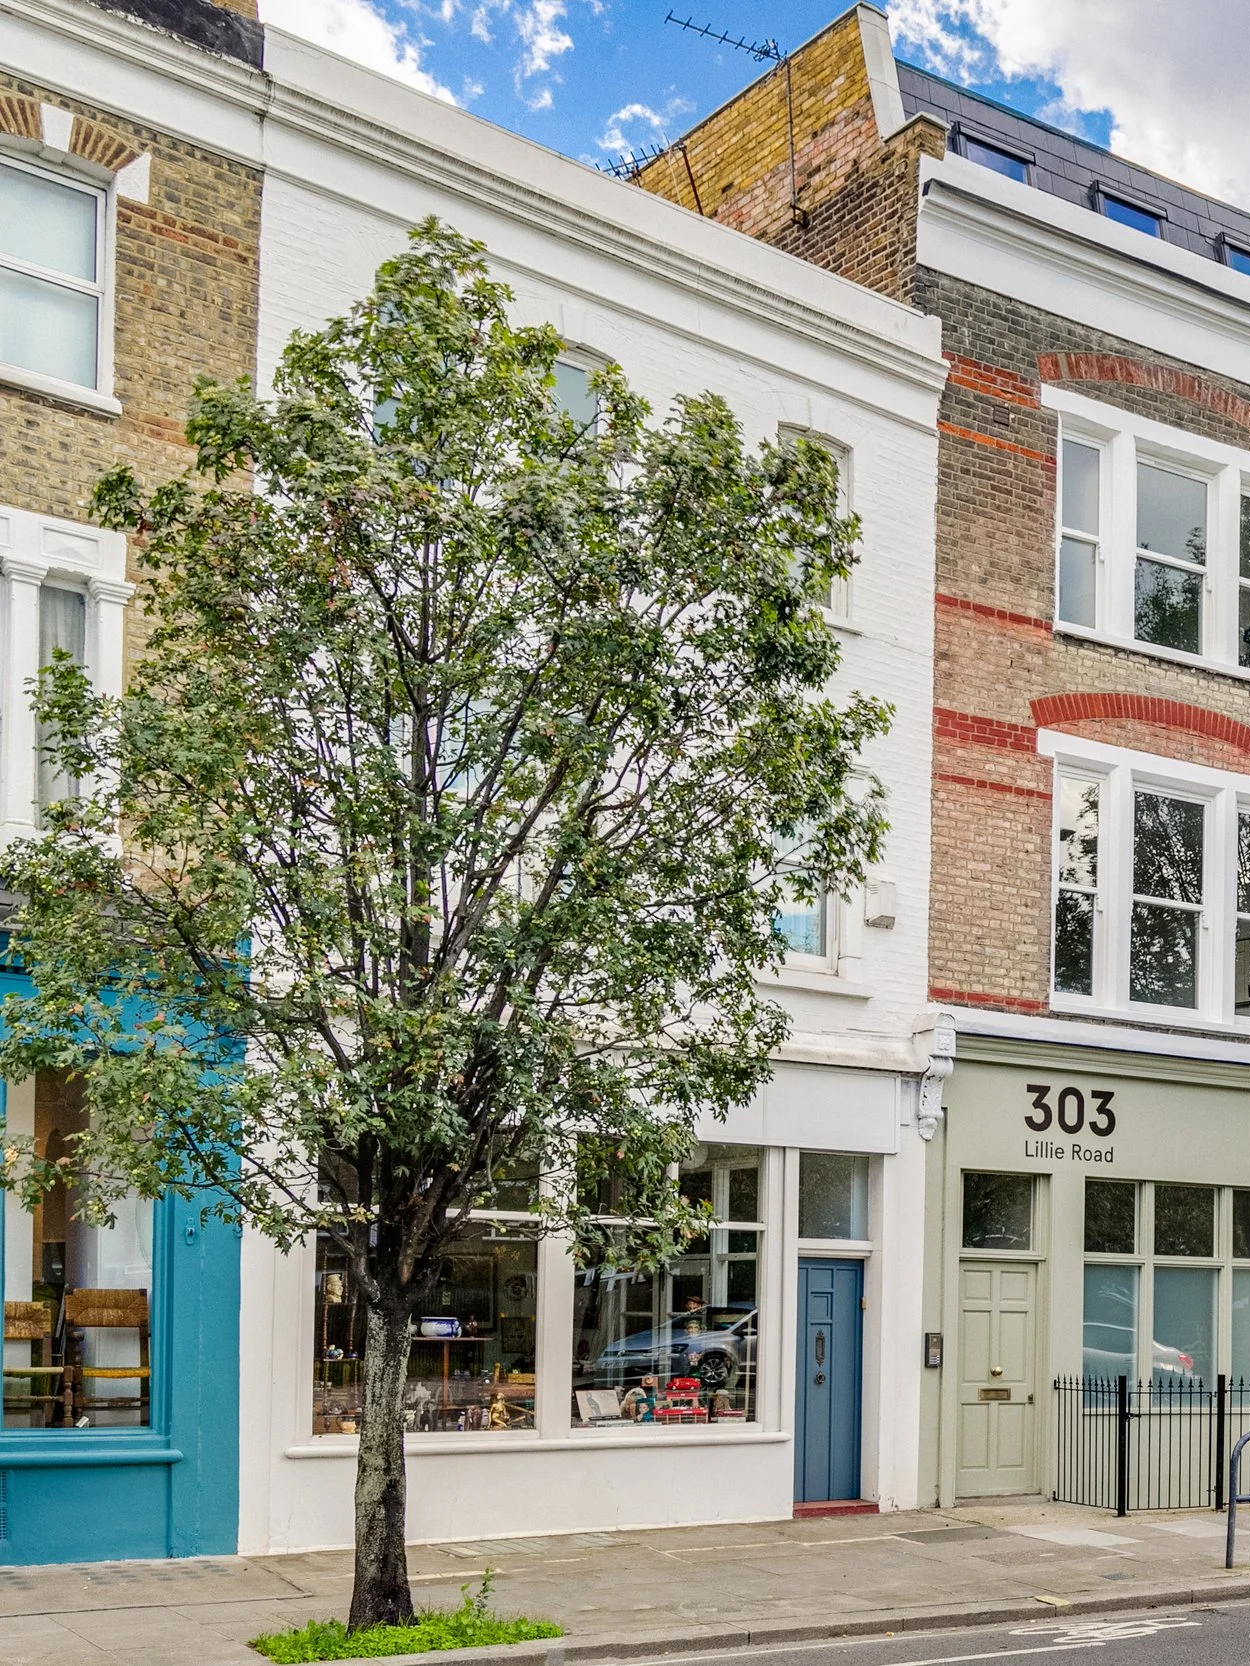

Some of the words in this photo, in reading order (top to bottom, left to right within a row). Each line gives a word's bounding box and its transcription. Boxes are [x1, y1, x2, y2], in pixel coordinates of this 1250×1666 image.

[1024, 1083, 1116, 1137] 303
[1025, 1140, 1065, 1159] Lillie
[1071, 1143, 1114, 1163] Road
